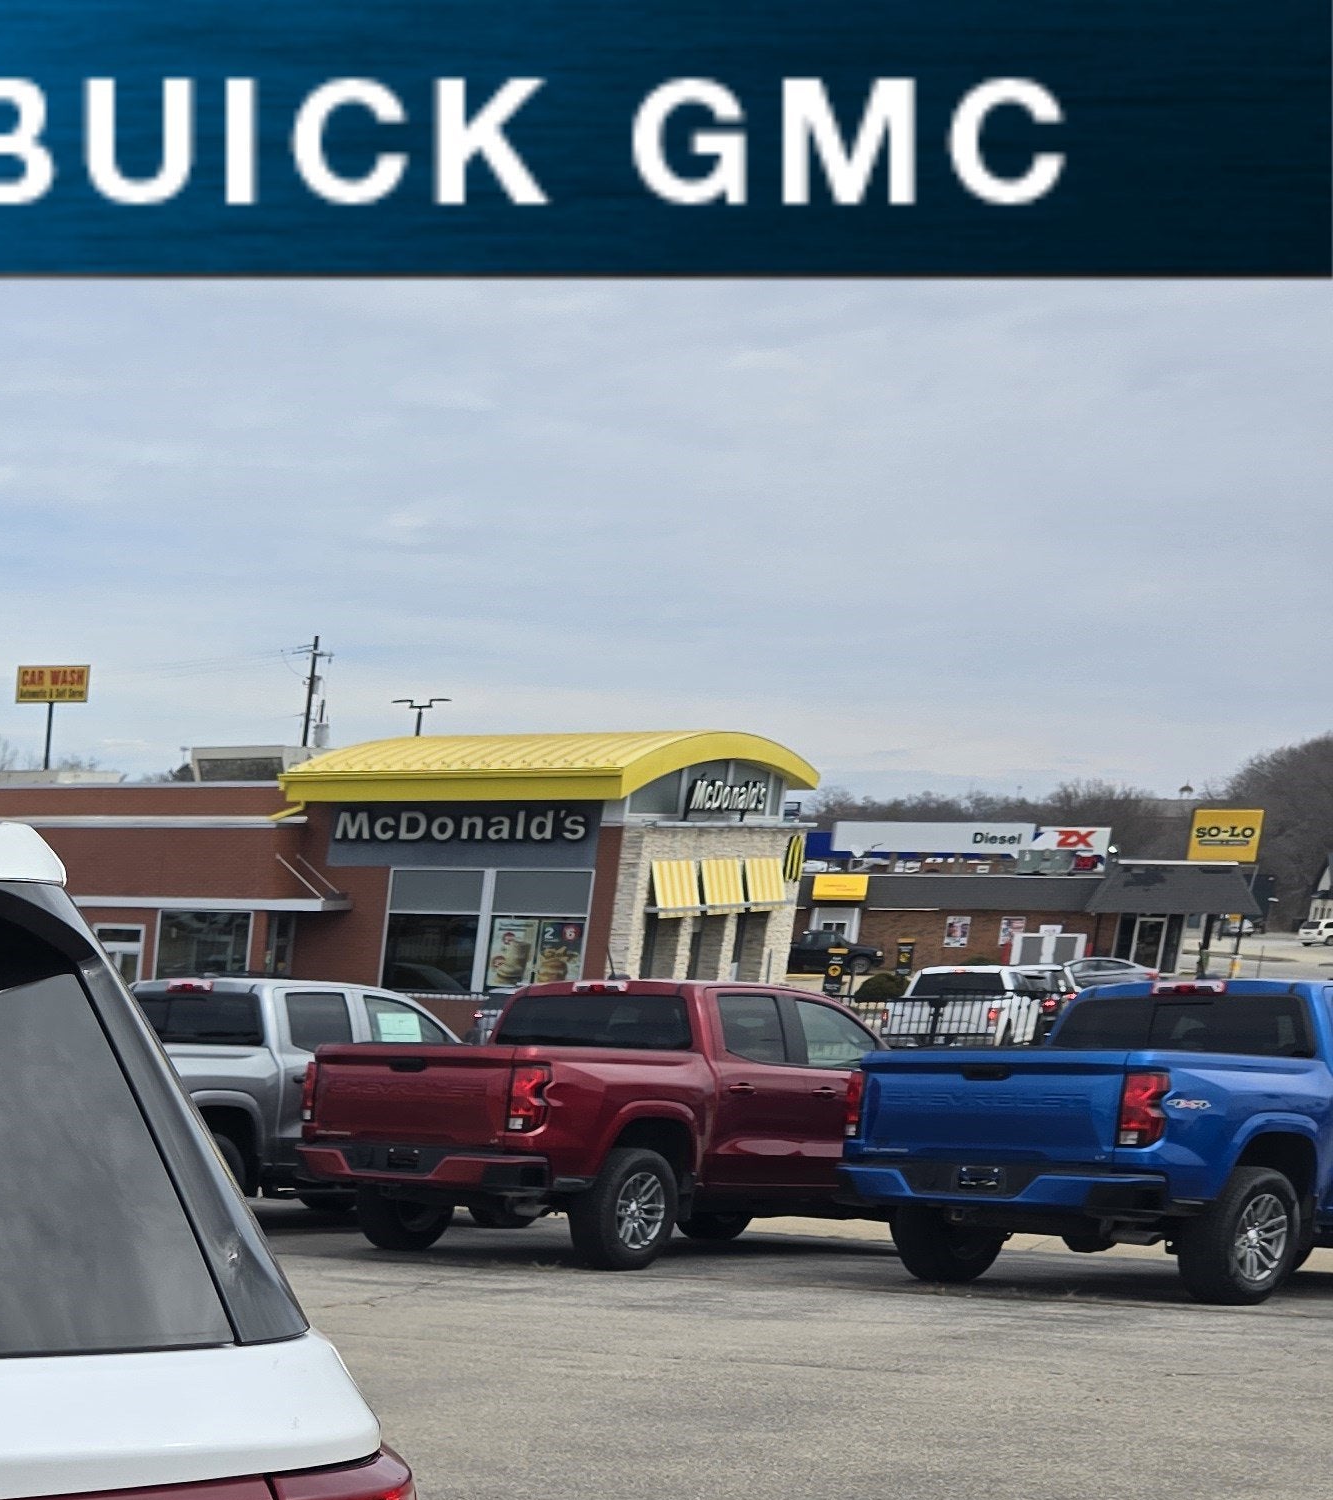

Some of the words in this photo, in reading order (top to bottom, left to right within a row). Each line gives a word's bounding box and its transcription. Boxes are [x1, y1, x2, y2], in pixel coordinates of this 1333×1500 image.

[21, 670, 44, 686] CAR
[50, 669, 85, 686] WASH
[692, 779, 766, 811] McDonald's
[334, 810, 586, 841] McDonald's
[1195, 826, 1255, 838] SO-LO
[972, 832, 1022, 845] Diesel
